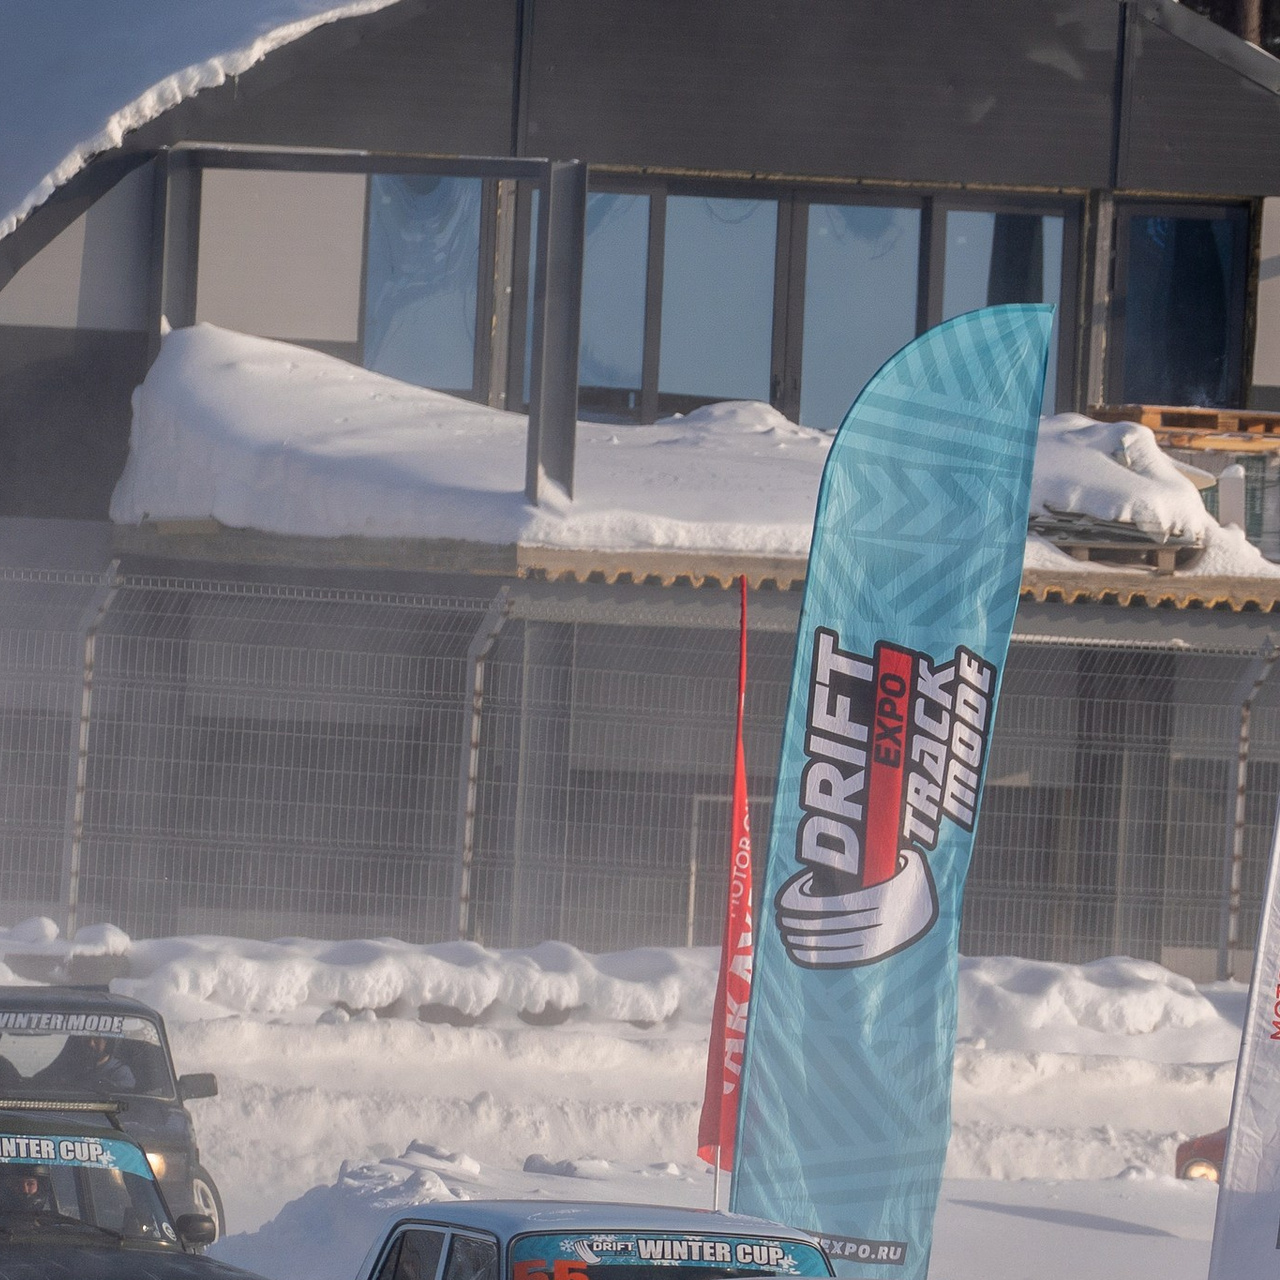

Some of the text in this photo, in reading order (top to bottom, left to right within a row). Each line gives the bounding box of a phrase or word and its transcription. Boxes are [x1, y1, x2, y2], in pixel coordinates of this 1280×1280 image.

[873, 672, 908, 769] EXPO
[903, 657, 956, 845] TRACK
[942, 651, 993, 826] MODE
[801, 632, 875, 876] DRIFT
[67, 1014, 124, 1033] MODE
[60, 1141, 104, 1163] CUP
[593, 1239, 784, 1266] DRIFT WINTER CUP
[811, 1237, 903, 1260] EXPO.RU
